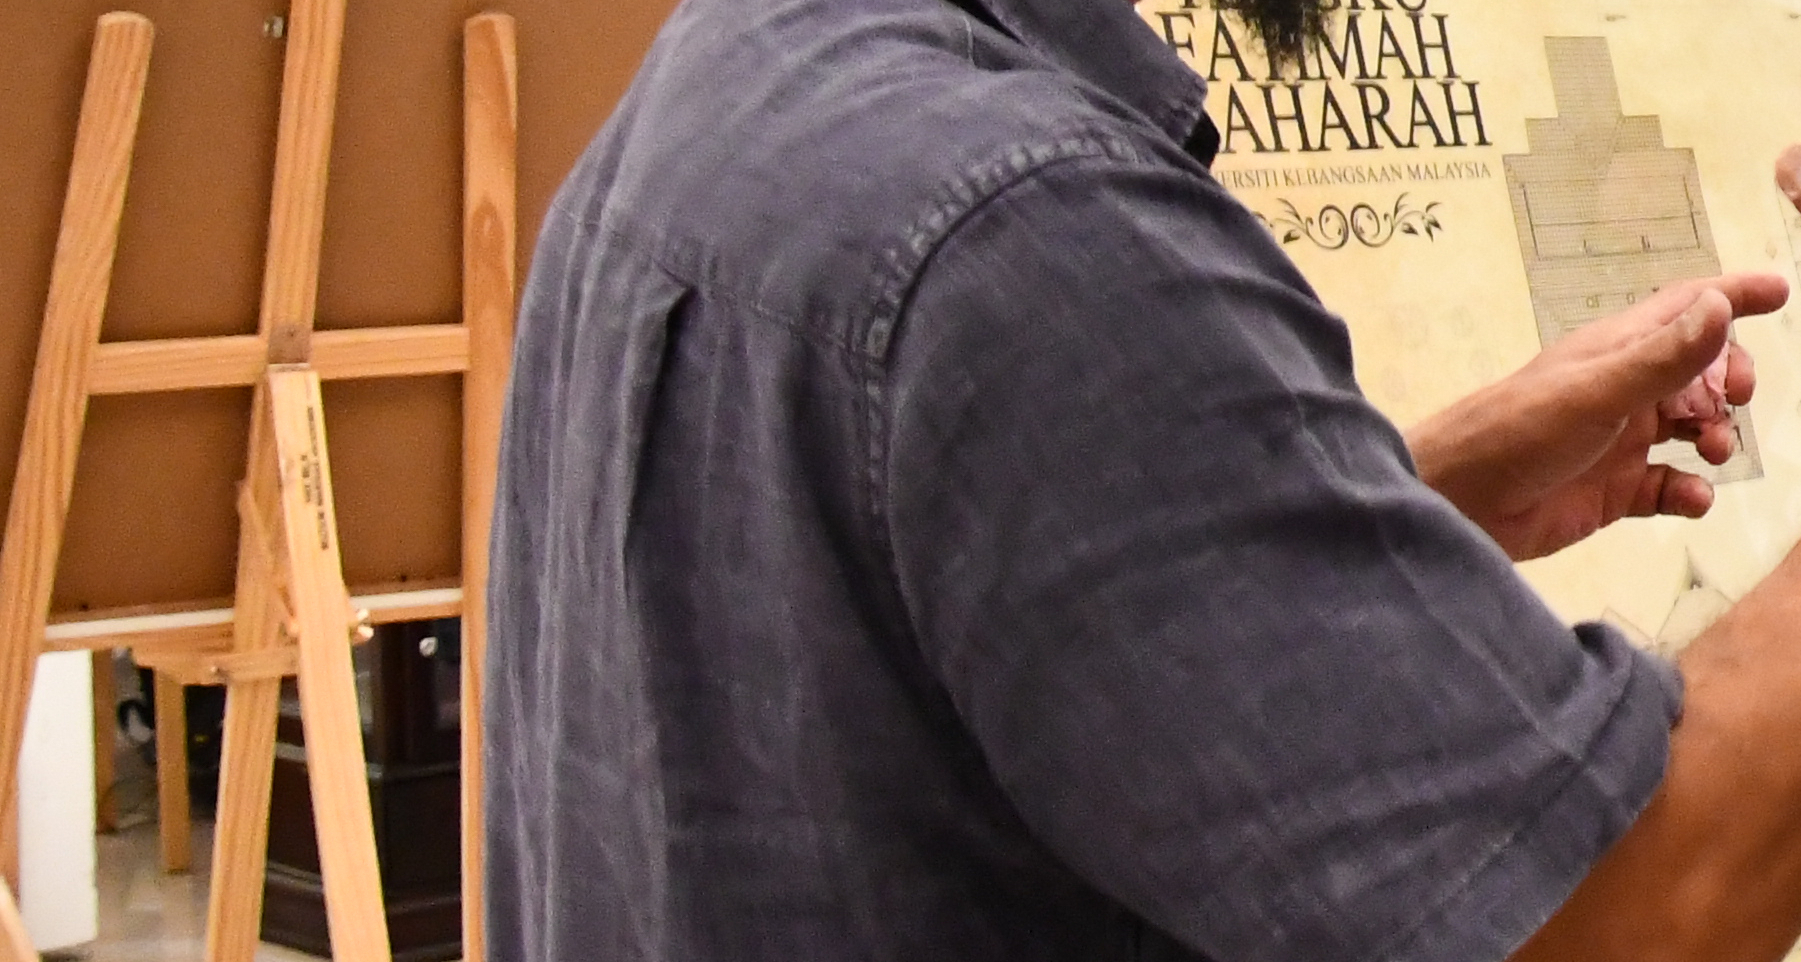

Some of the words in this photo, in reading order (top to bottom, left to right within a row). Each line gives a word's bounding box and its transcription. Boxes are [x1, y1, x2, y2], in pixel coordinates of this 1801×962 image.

[1220, 78, 1493, 154] AHARAH
[1215, 168, 1278, 189] ERSITI
[1282, 163, 1402, 188] KEBANGSAAN
[1407, 160, 1492, 182] MALAYSIA
